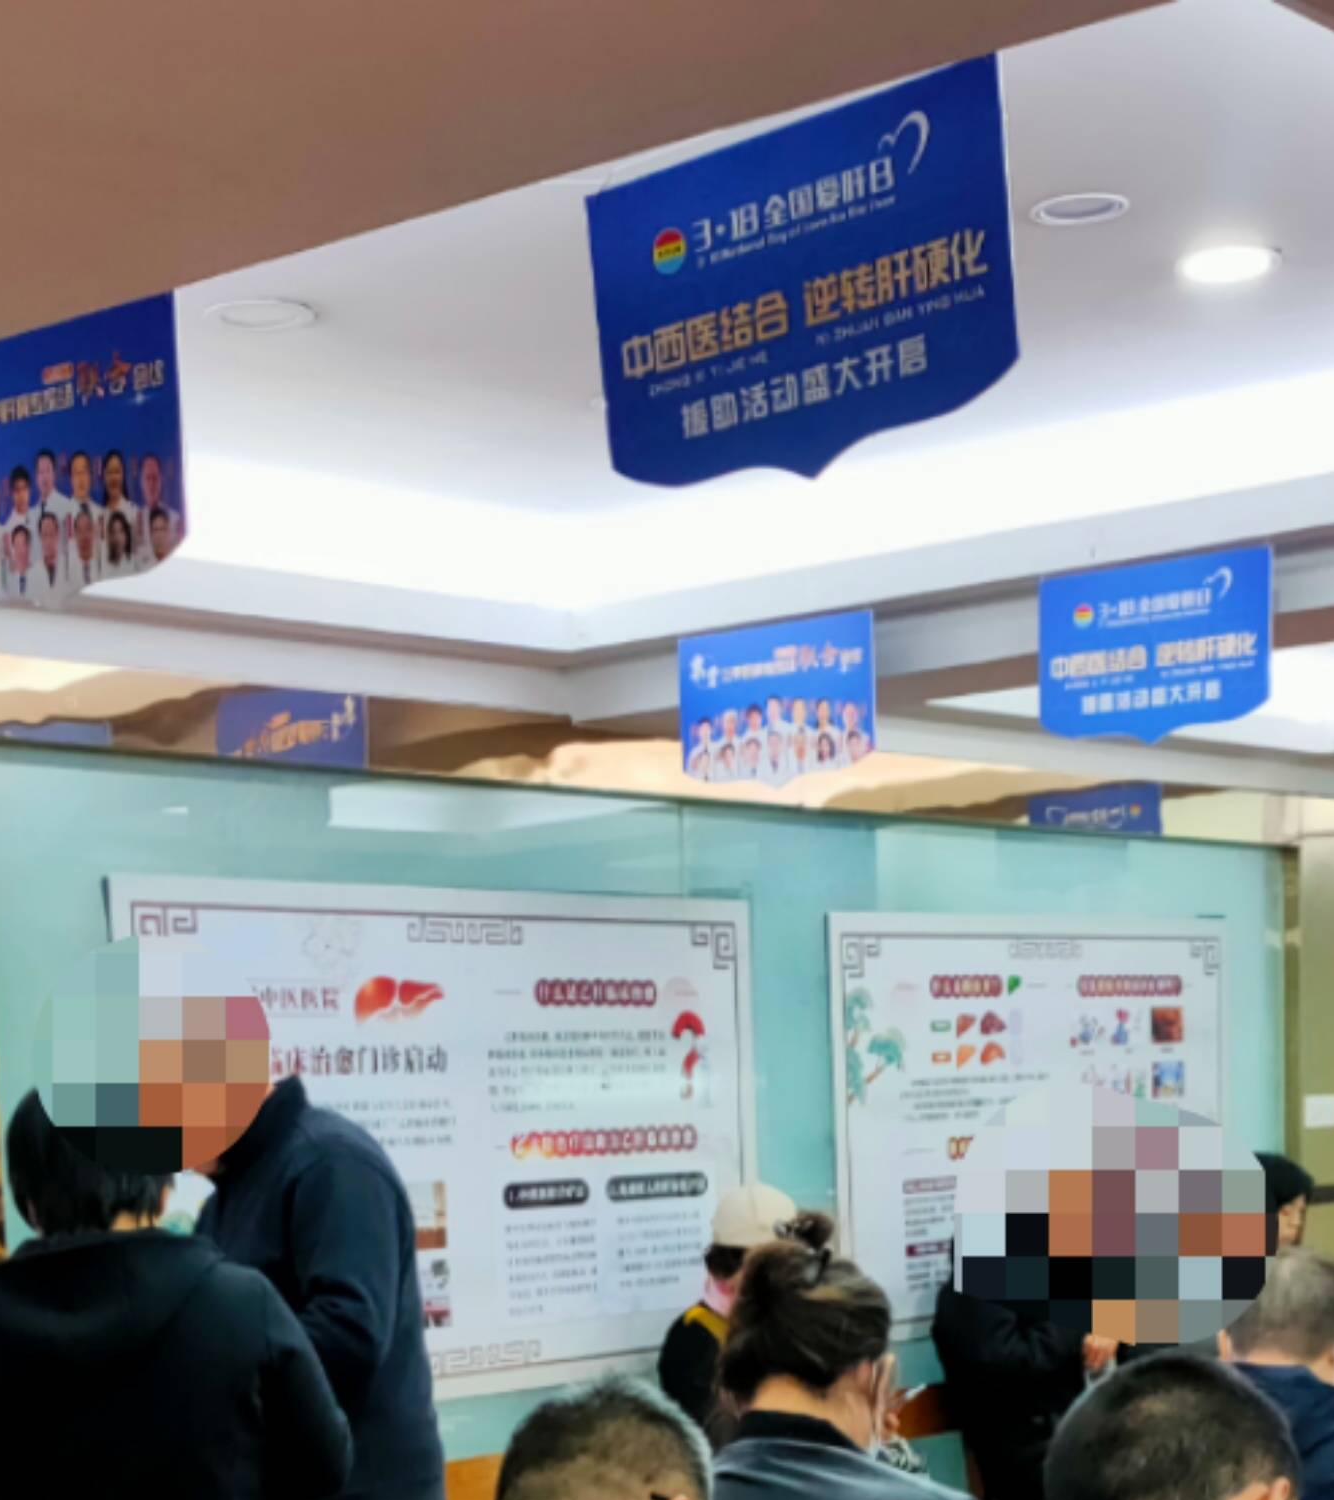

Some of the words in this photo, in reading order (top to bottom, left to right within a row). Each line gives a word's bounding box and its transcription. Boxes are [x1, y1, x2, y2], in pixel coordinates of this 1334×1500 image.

[621, 290, 789, 379] 中西医结合
[803, 228, 989, 327] 逆转肝硬化
[681, 333, 928, 439] 援助活动盛大开启
[258, 985, 340, 1011] 中医医院
